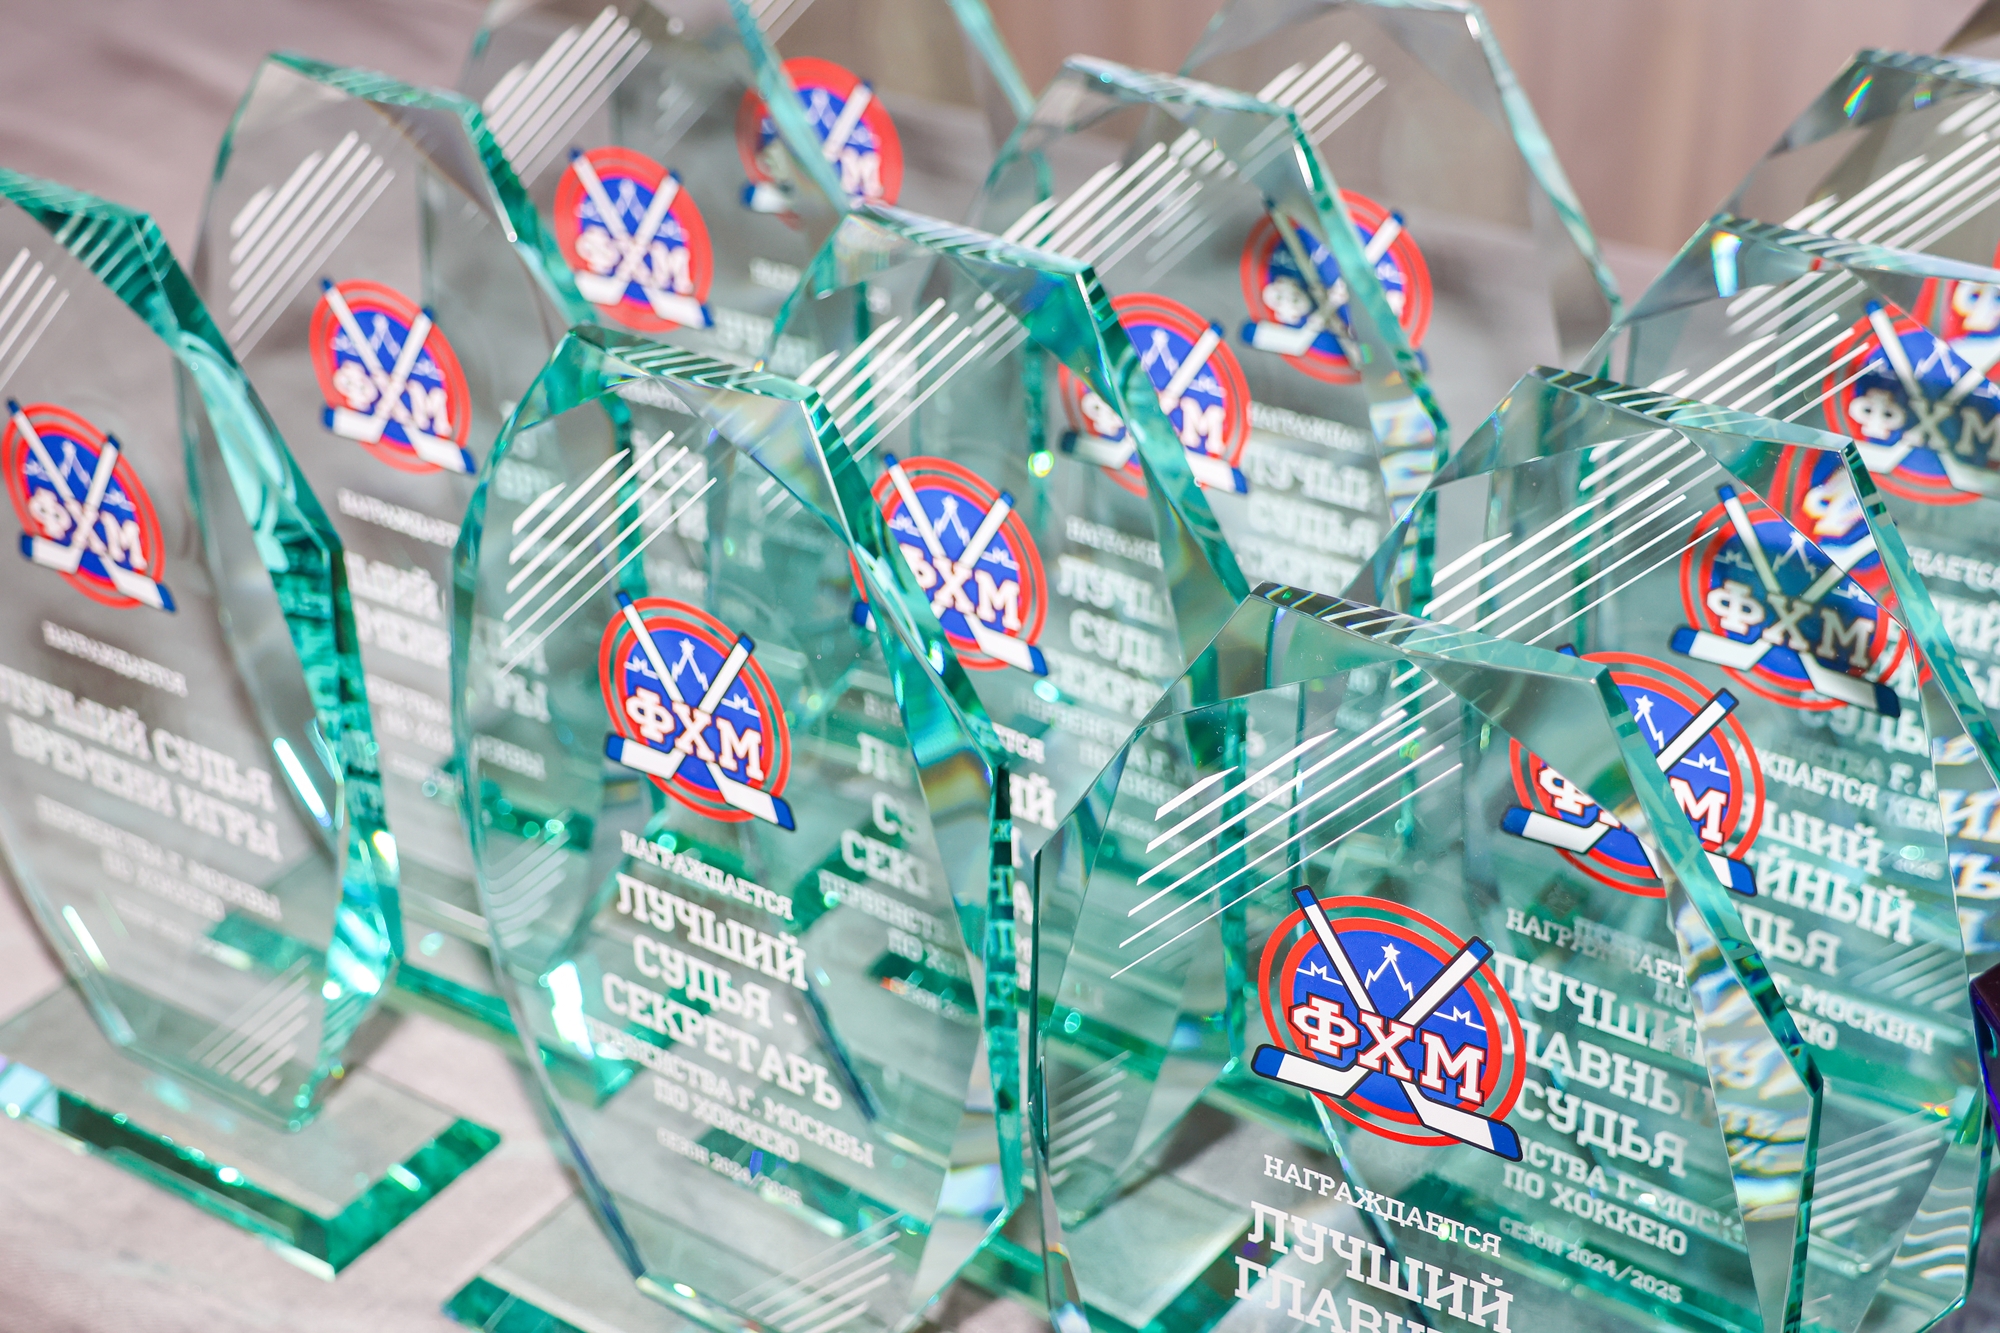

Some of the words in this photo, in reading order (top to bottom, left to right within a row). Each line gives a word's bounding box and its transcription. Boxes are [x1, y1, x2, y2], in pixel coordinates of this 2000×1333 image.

[28, 486, 148, 572] ФХМ
[1706, 578, 1876, 670] ФХМ
[625, 686, 766, 782] ФХМ
[1538, 766, 1728, 845] ФМ
[619, 830, 794, 921] НАГРАЖДАЕТСЯ
[616, 872, 809, 991] ЛУЧШИЙ
[632, 934, 774, 1029] СУДЬЯ
[1799, 983, 1936, 1056] МОСКВЫ
[602, 972, 843, 1111] СЕКРЕТАРЬ
[1289, 993, 1486, 1107] ФХМ
[1515, 1078, 1689, 1178] СУДЬЯ
[1263, 1153, 1502, 1258] НАГРАЖДАЕТСЯ
[1502, 1162, 1546, 1200] ПО
[1550, 1181, 1688, 1257] ХОККЕЮ
[1234, 1255, 1437, 1333] ГЛАВ
[1247, 1199, 1514, 1333] ЛУЧШИЙ
[1498, 1215, 1564, 1257] СЕЗОН
[1566, 1243, 1683, 1305] 2024/2025
